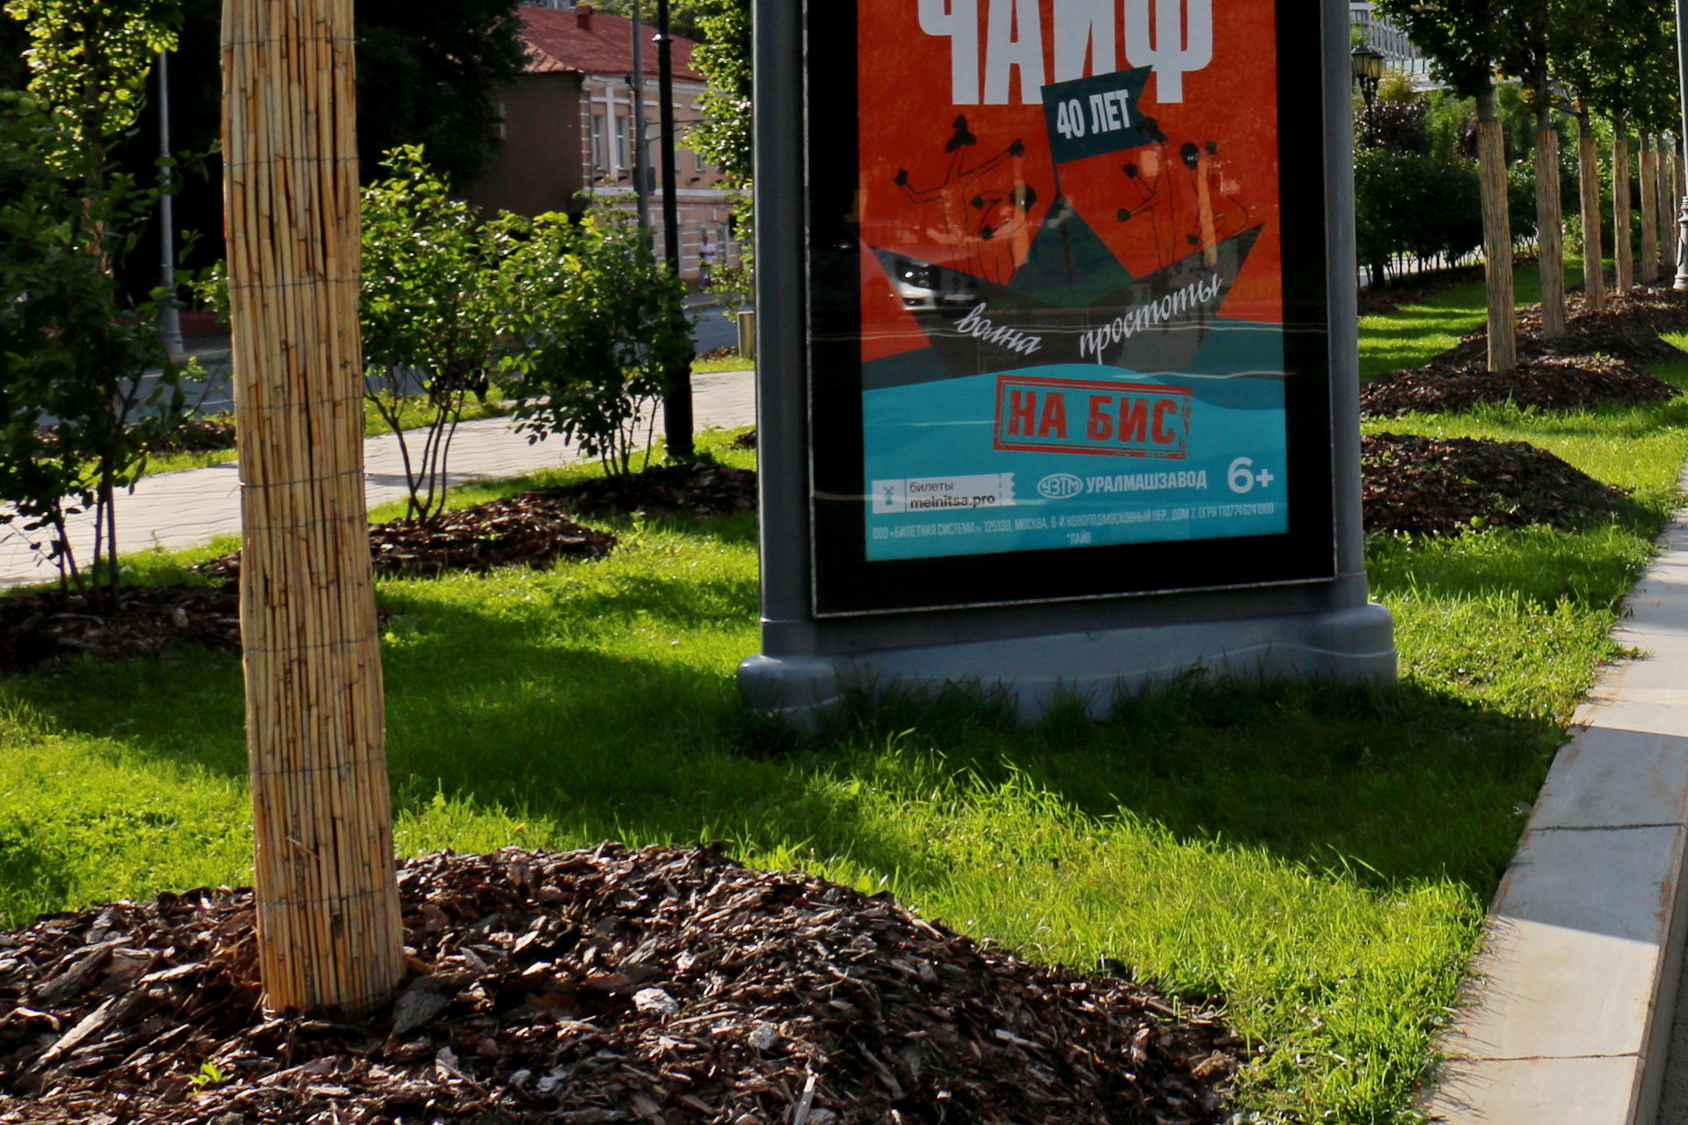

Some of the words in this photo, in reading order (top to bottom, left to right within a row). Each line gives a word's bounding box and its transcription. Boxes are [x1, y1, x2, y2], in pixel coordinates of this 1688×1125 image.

[1057, 99, 1085, 140] 40
[1091, 89, 1131, 135] ЛЕТ
[953, 302, 1042, 355] волна
[1080, 273, 1222, 365] простоты
[1008, 390, 1067, 438] НА
[1087, 395, 1177, 445] БИС
[909, 481, 954, 493] билеты
[1086, 470, 1208, 493] УРАЛМАШЗАВОД
[1227, 457, 1274, 494] 6+
